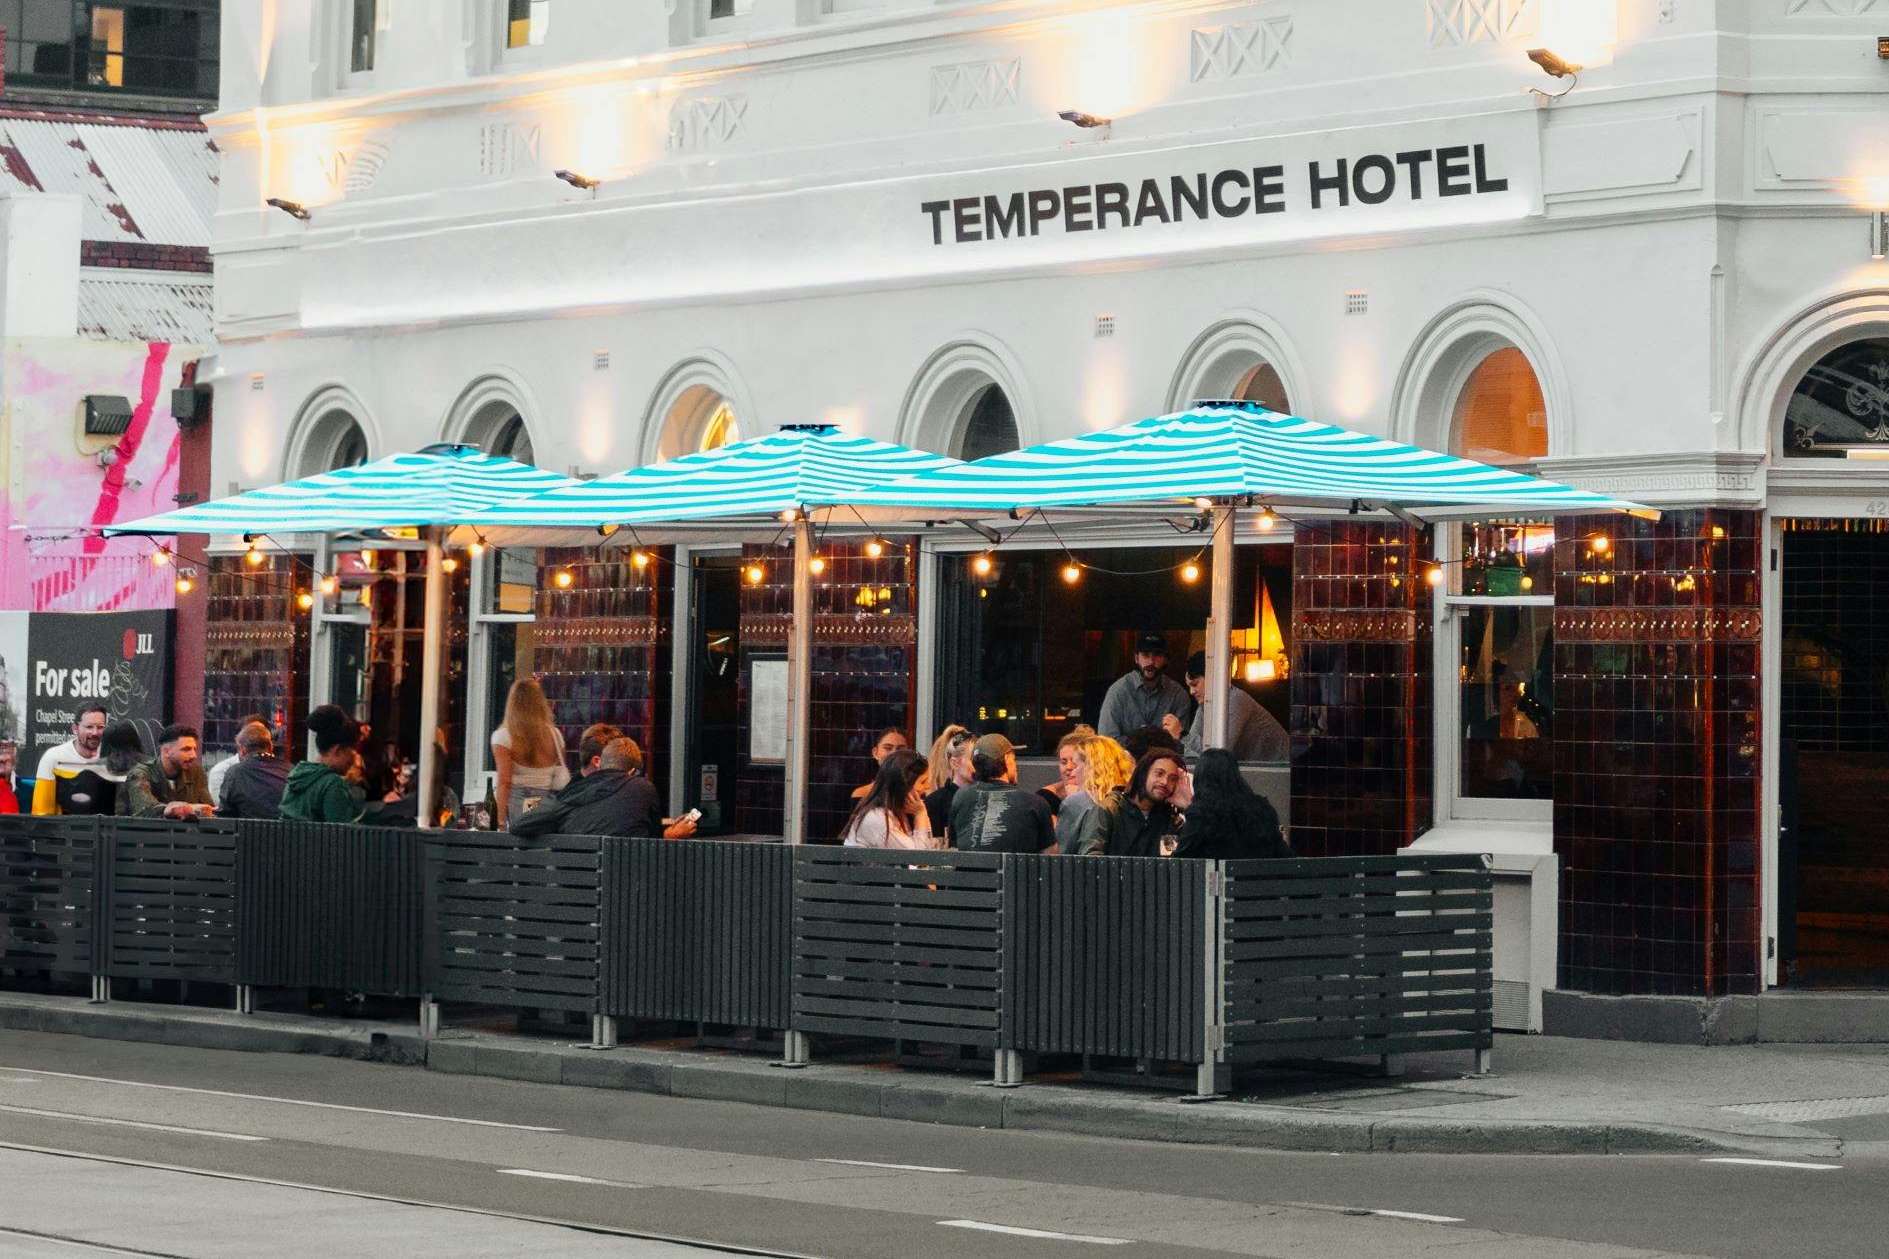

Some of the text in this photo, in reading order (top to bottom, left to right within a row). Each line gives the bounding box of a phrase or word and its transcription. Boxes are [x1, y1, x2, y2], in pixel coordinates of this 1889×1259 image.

[921, 143, 1508, 245] TEMPERANCE HOTEL
[136, 633, 154, 654] JLL
[35, 660, 68, 697] For
[70, 658, 111, 698] sale
[35, 708, 76, 726] Chapel Stree
